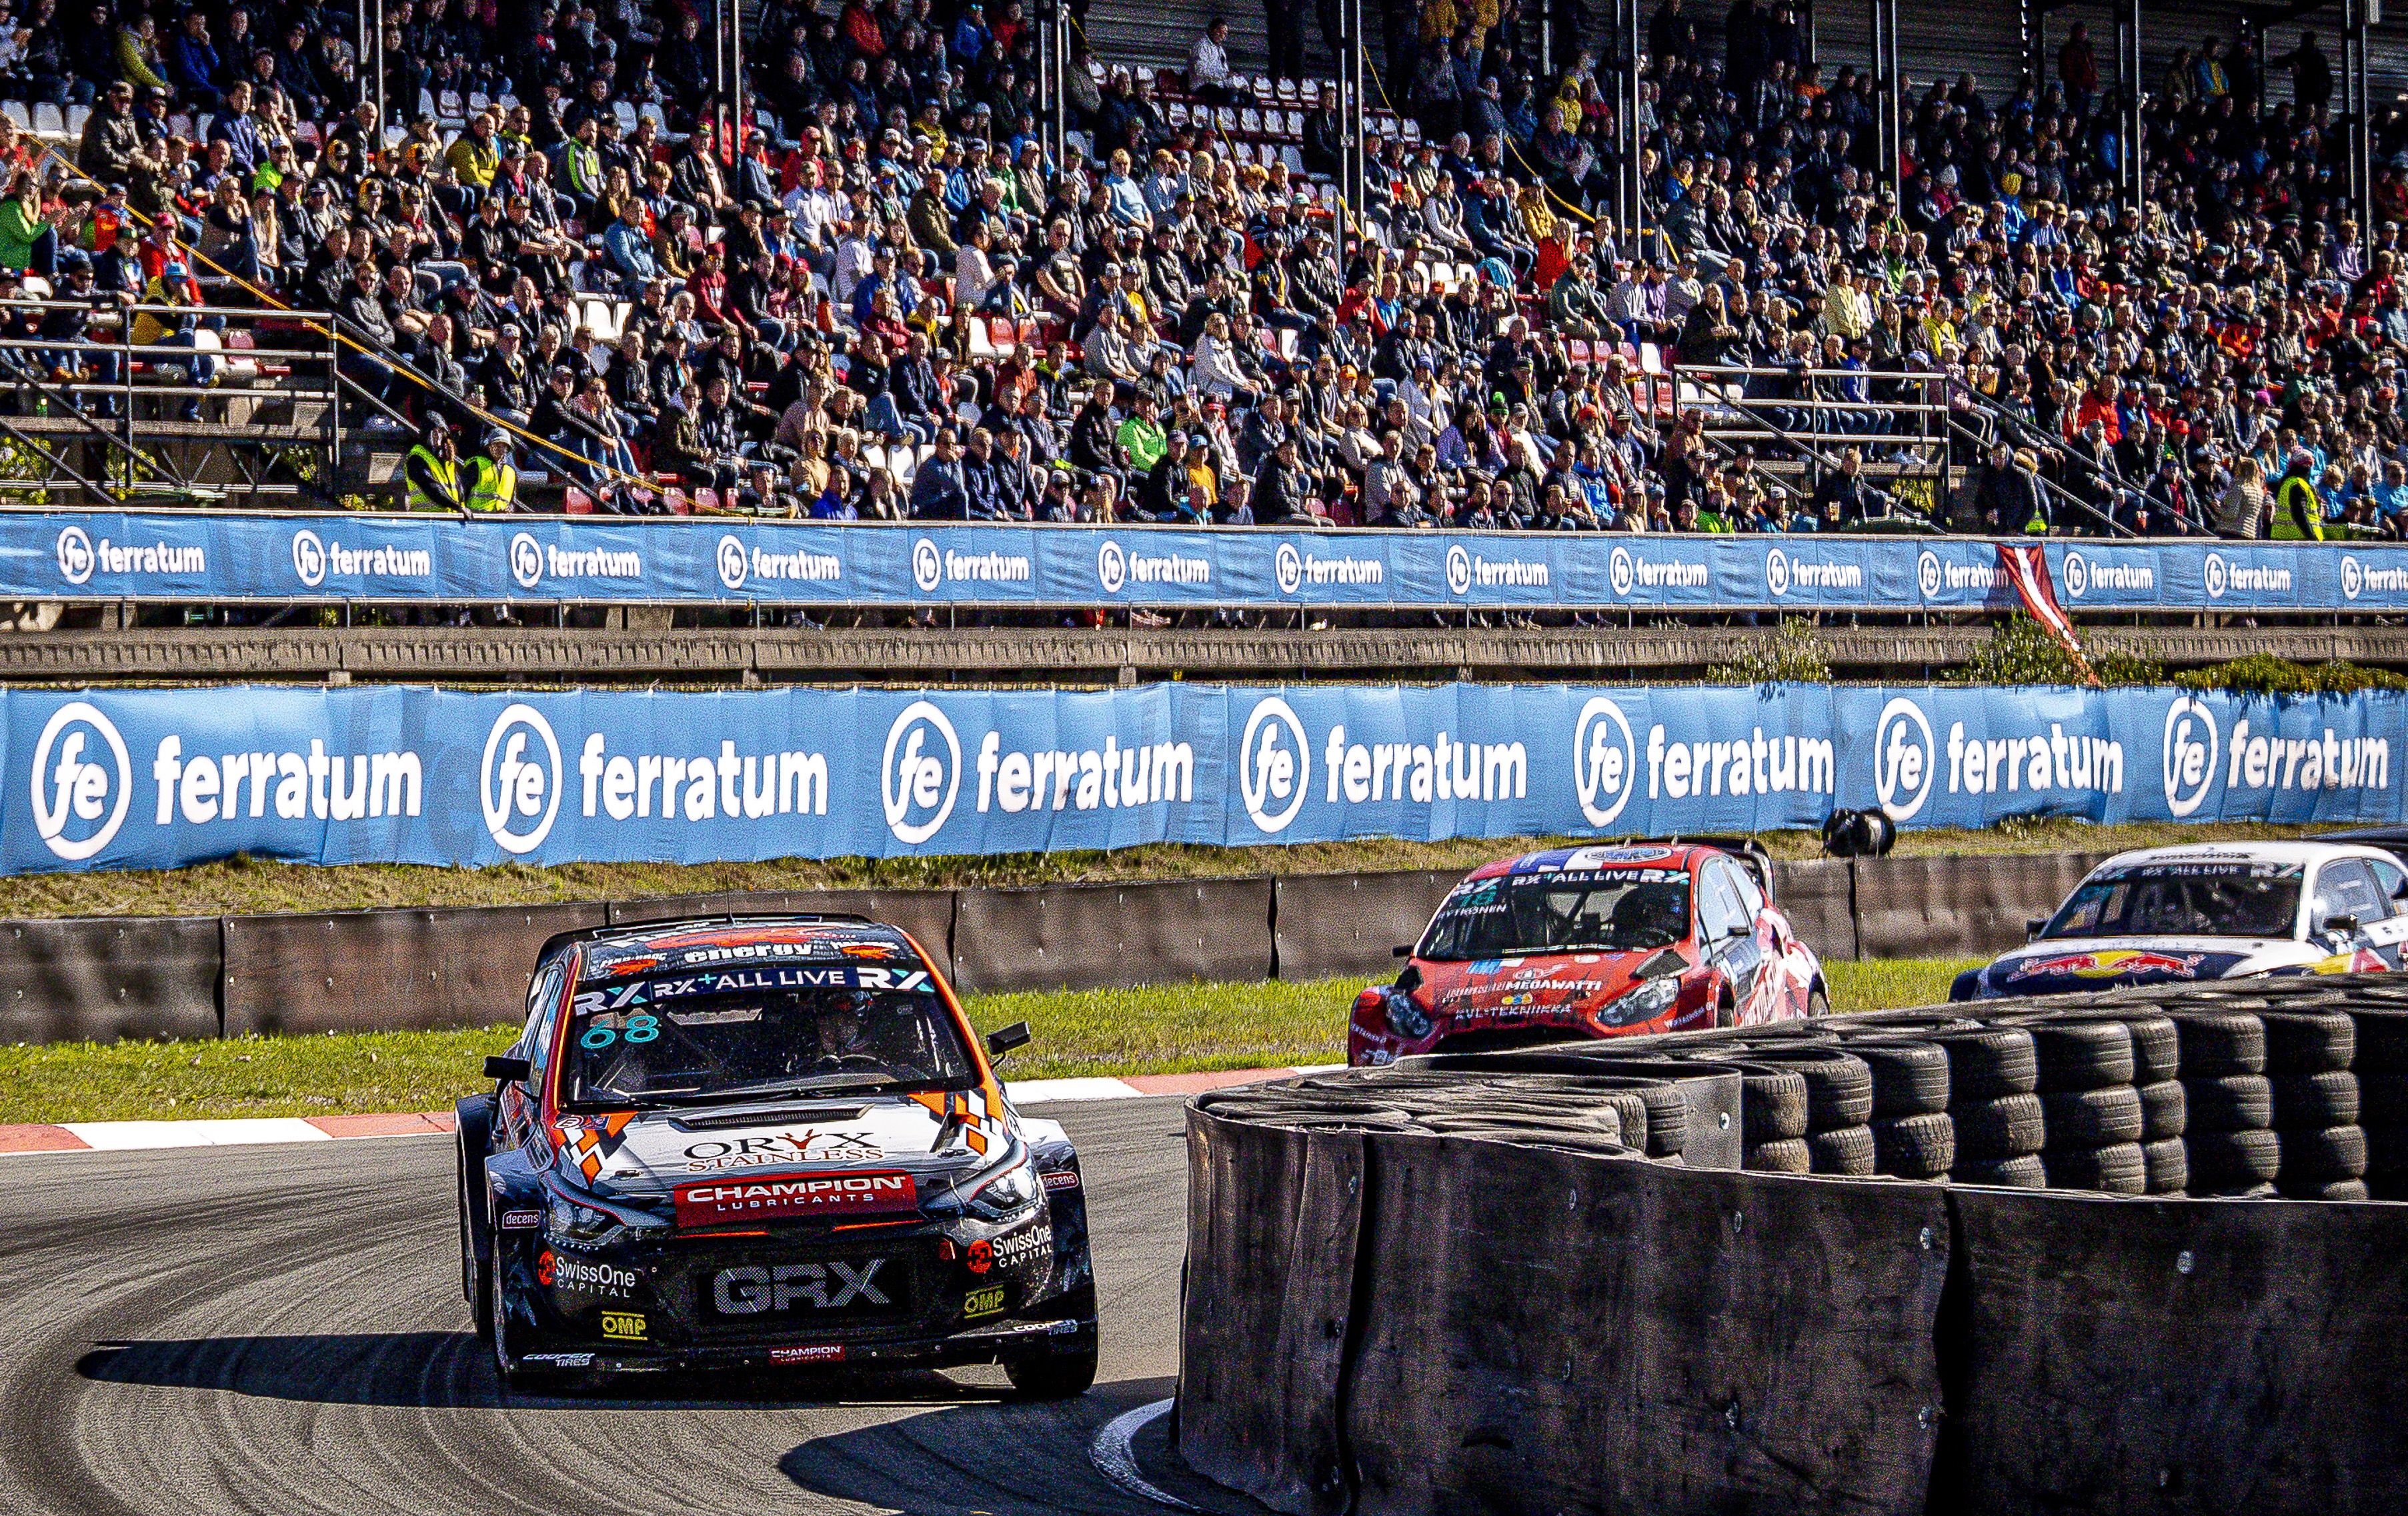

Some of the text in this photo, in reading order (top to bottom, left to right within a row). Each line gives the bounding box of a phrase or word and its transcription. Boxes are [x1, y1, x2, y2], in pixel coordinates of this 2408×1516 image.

[97, 539, 205, 573] ferratum
[329, 541, 431, 576] ferratum
[547, 544, 641, 577] ferratum
[752, 546, 841, 581] ferratum
[945, 549, 1030, 581] ferratum
[1129, 551, 1210, 583] ferratum
[1304, 553, 1383, 584] ferratum
[1474, 555, 1548, 586] ferratum
[1636, 556, 1708, 587] ferratum
[1791, 557, 1862, 587] ferratum
[1944, 559, 2009, 589] ferratum
[2090, 561, 2153, 589] ferratum
[2229, 562, 2291, 590] ferratum
[2363, 564, 2408, 590] ferratu
[1325, 725, 1526, 803] ferratum
[1647, 724, 1834, 799] ferratum
[1947, 721, 2123, 794] ferratum
[2228, 719, 2388, 788] ferratum
[153, 735, 422, 824] ferratum
[579, 733, 828, 821] ferratum
[977, 731, 1194, 812] ferratum
[1552, 872, 1590, 884] ALL
[1594, 870, 1638, 881] LIVE
[684, 943, 812, 963] energy
[716, 971, 773, 991] ALL
[779, 970, 846, 985] LIVE
[857, 967, 934, 993] RX
[580, 1015, 660, 1050] 68
[684, 1129, 881, 1159] ORYX
[689, 1149, 884, 1172] STAINLESS
[687, 1177, 906, 1203] CHAMPION
[1043, 1175, 1076, 1187] decens
[718, 1193, 874, 1211] LUBRICANTS
[505, 1213, 539, 1226] decens
[992, 1225, 1052, 1257] SwissOne
[998, 1243, 1052, 1268] CAPITAL
[555, 1256, 636, 1287] SwissOne
[714, 1258, 892, 1314] GRX
[557, 1278, 630, 1298] CAPITAL
[965, 1291, 1004, 1313] OMP
[602, 1316, 646, 1335] OMP
[555, 1359, 590, 1367] TIRES
[771, 1346, 842, 1357] CHAMPION
